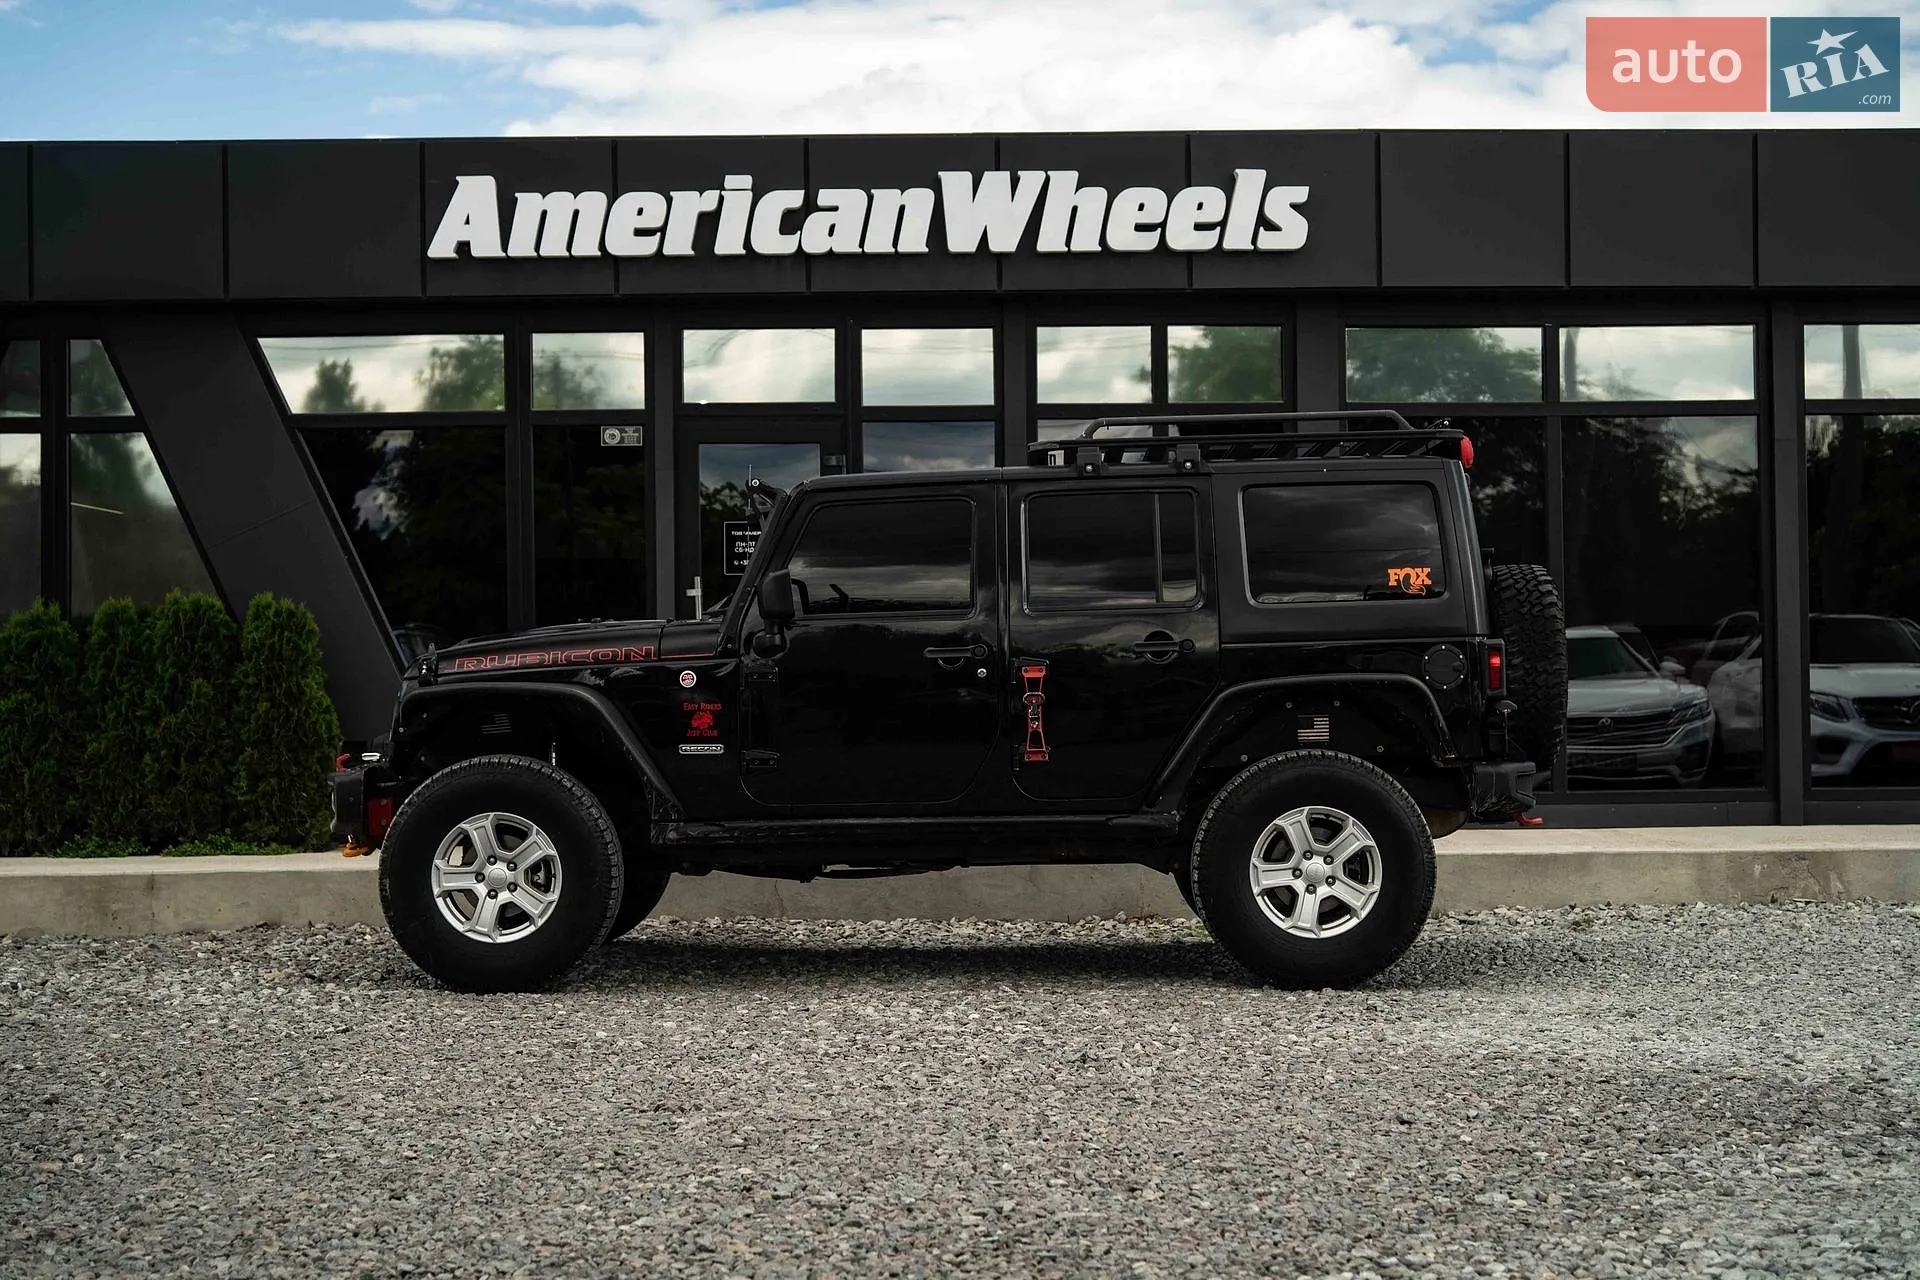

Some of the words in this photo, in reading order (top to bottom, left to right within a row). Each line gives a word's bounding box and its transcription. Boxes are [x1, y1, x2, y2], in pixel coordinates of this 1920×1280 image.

[428, 168, 1310, 259] AmericanWheels
[1387, 567, 1432, 596] FOX
[455, 645, 657, 672] RUBICON
